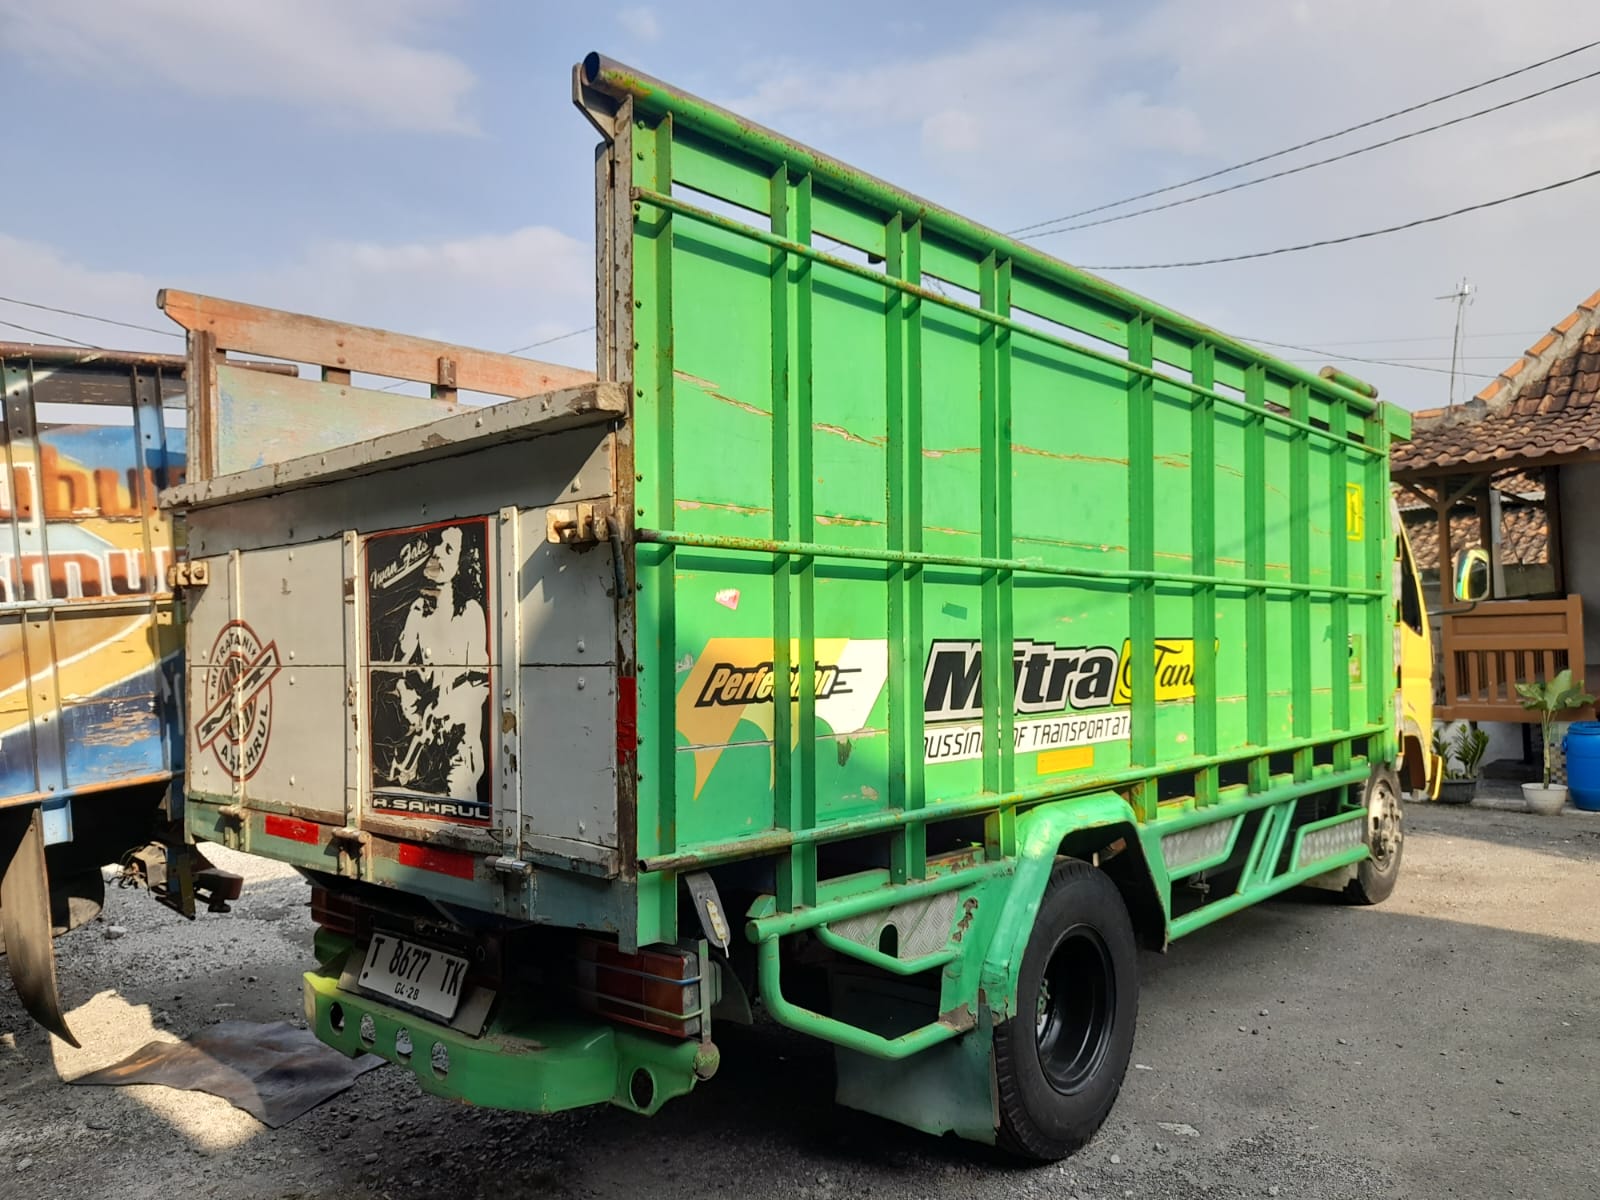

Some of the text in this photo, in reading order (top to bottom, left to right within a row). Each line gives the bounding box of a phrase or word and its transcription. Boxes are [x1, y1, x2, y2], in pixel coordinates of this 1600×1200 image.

[695, 662, 839, 707] Perfen
[925, 639, 1194, 720] Mtra Tan
[924, 730, 983, 759] USSIN
[371, 937, 465, 997] T 8677 TK
